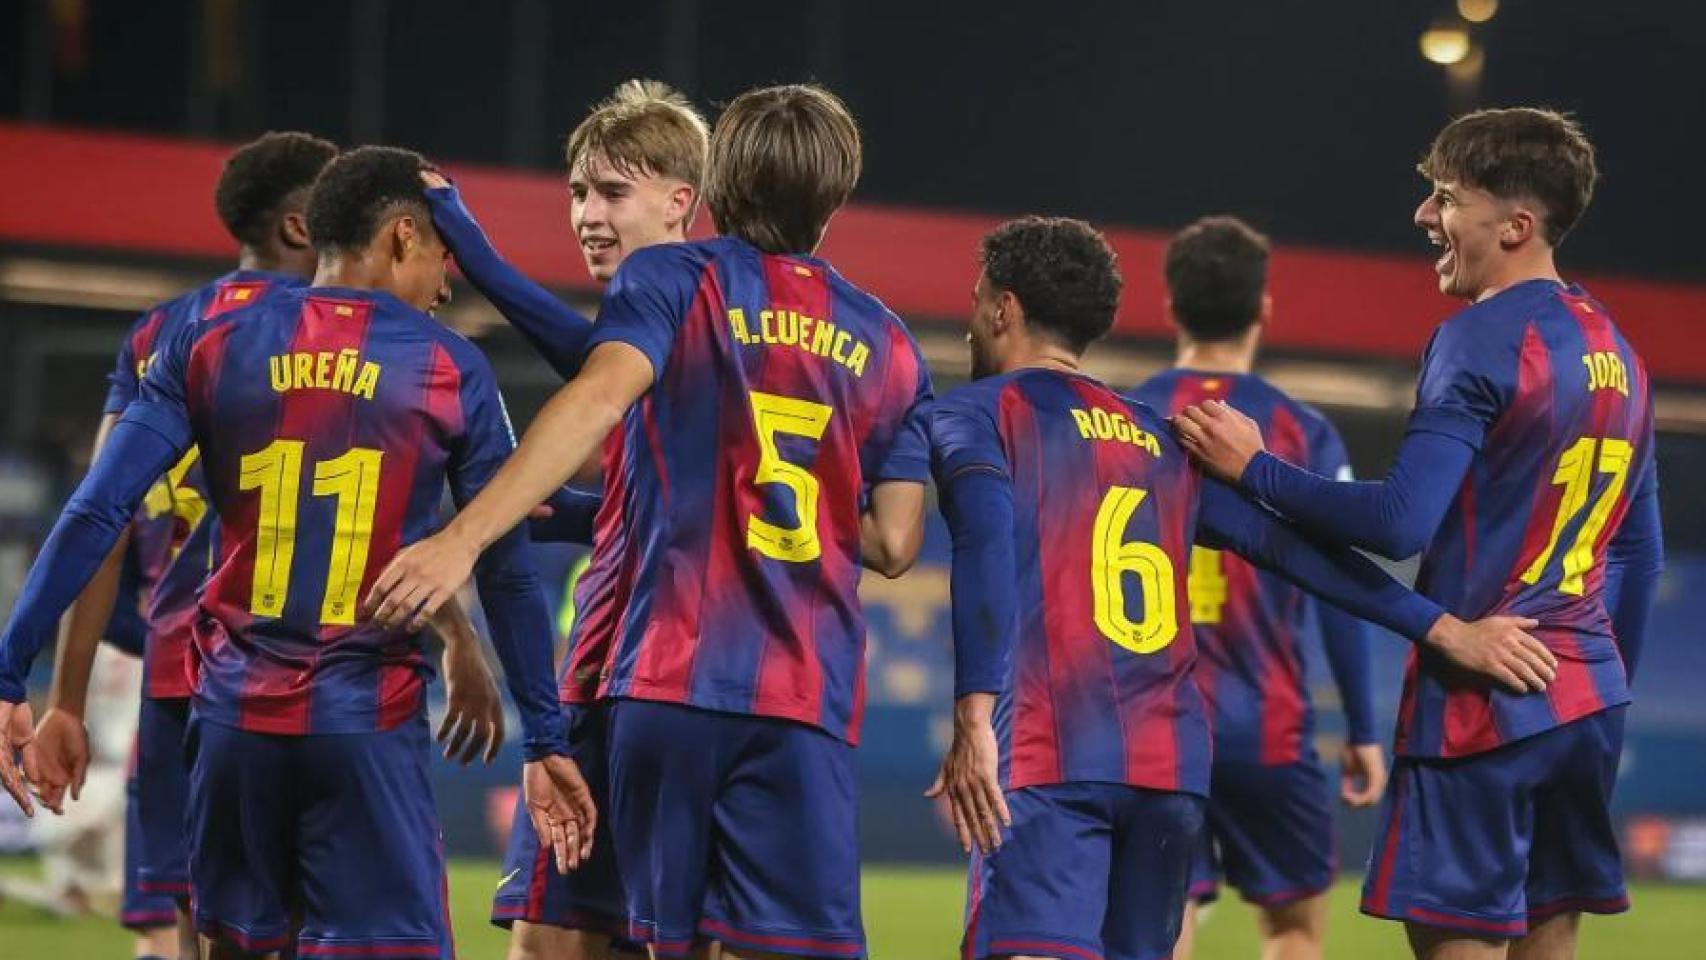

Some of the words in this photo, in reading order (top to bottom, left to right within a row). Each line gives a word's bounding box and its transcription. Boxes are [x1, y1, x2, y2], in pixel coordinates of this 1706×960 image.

[270, 347, 381, 400] UREÑA
[728, 308, 870, 377] A.CUENCA
[746, 390, 833, 563] 5
[1070, 407, 1161, 458] ROGER
[239, 439, 383, 626] 11
[1090, 485, 1179, 655] 6
[1519, 437, 1634, 596] 17
